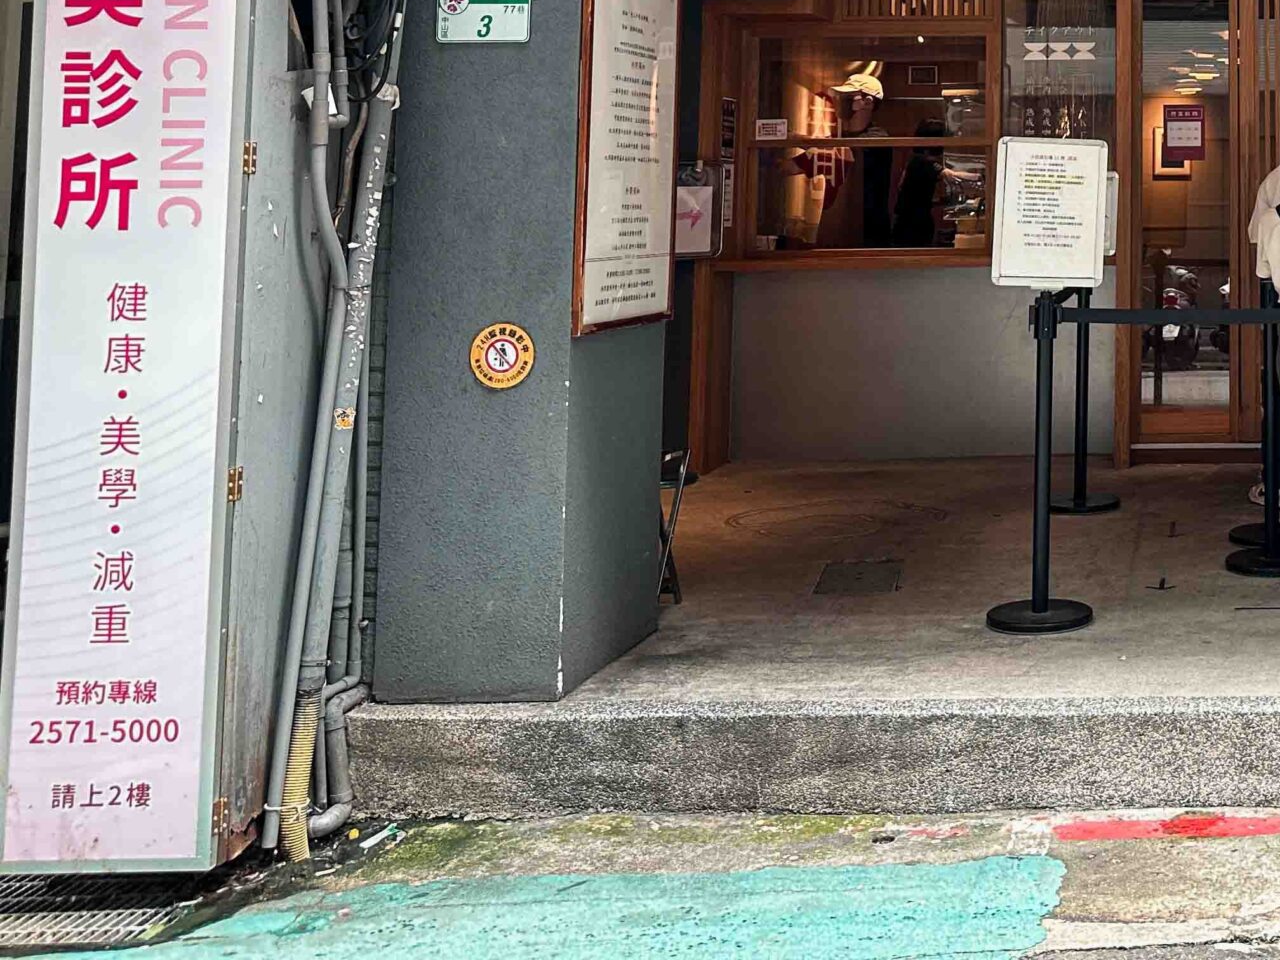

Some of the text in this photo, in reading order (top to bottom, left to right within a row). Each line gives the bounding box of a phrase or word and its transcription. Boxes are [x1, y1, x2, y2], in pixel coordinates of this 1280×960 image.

[477, 14, 493, 38] 3
[157, 48, 208, 229] CLINIC
[55, 679, 158, 706] 預約專線
[29, 718, 180, 745] 2571-5000
[51, 781, 152, 810] 請上2樓
